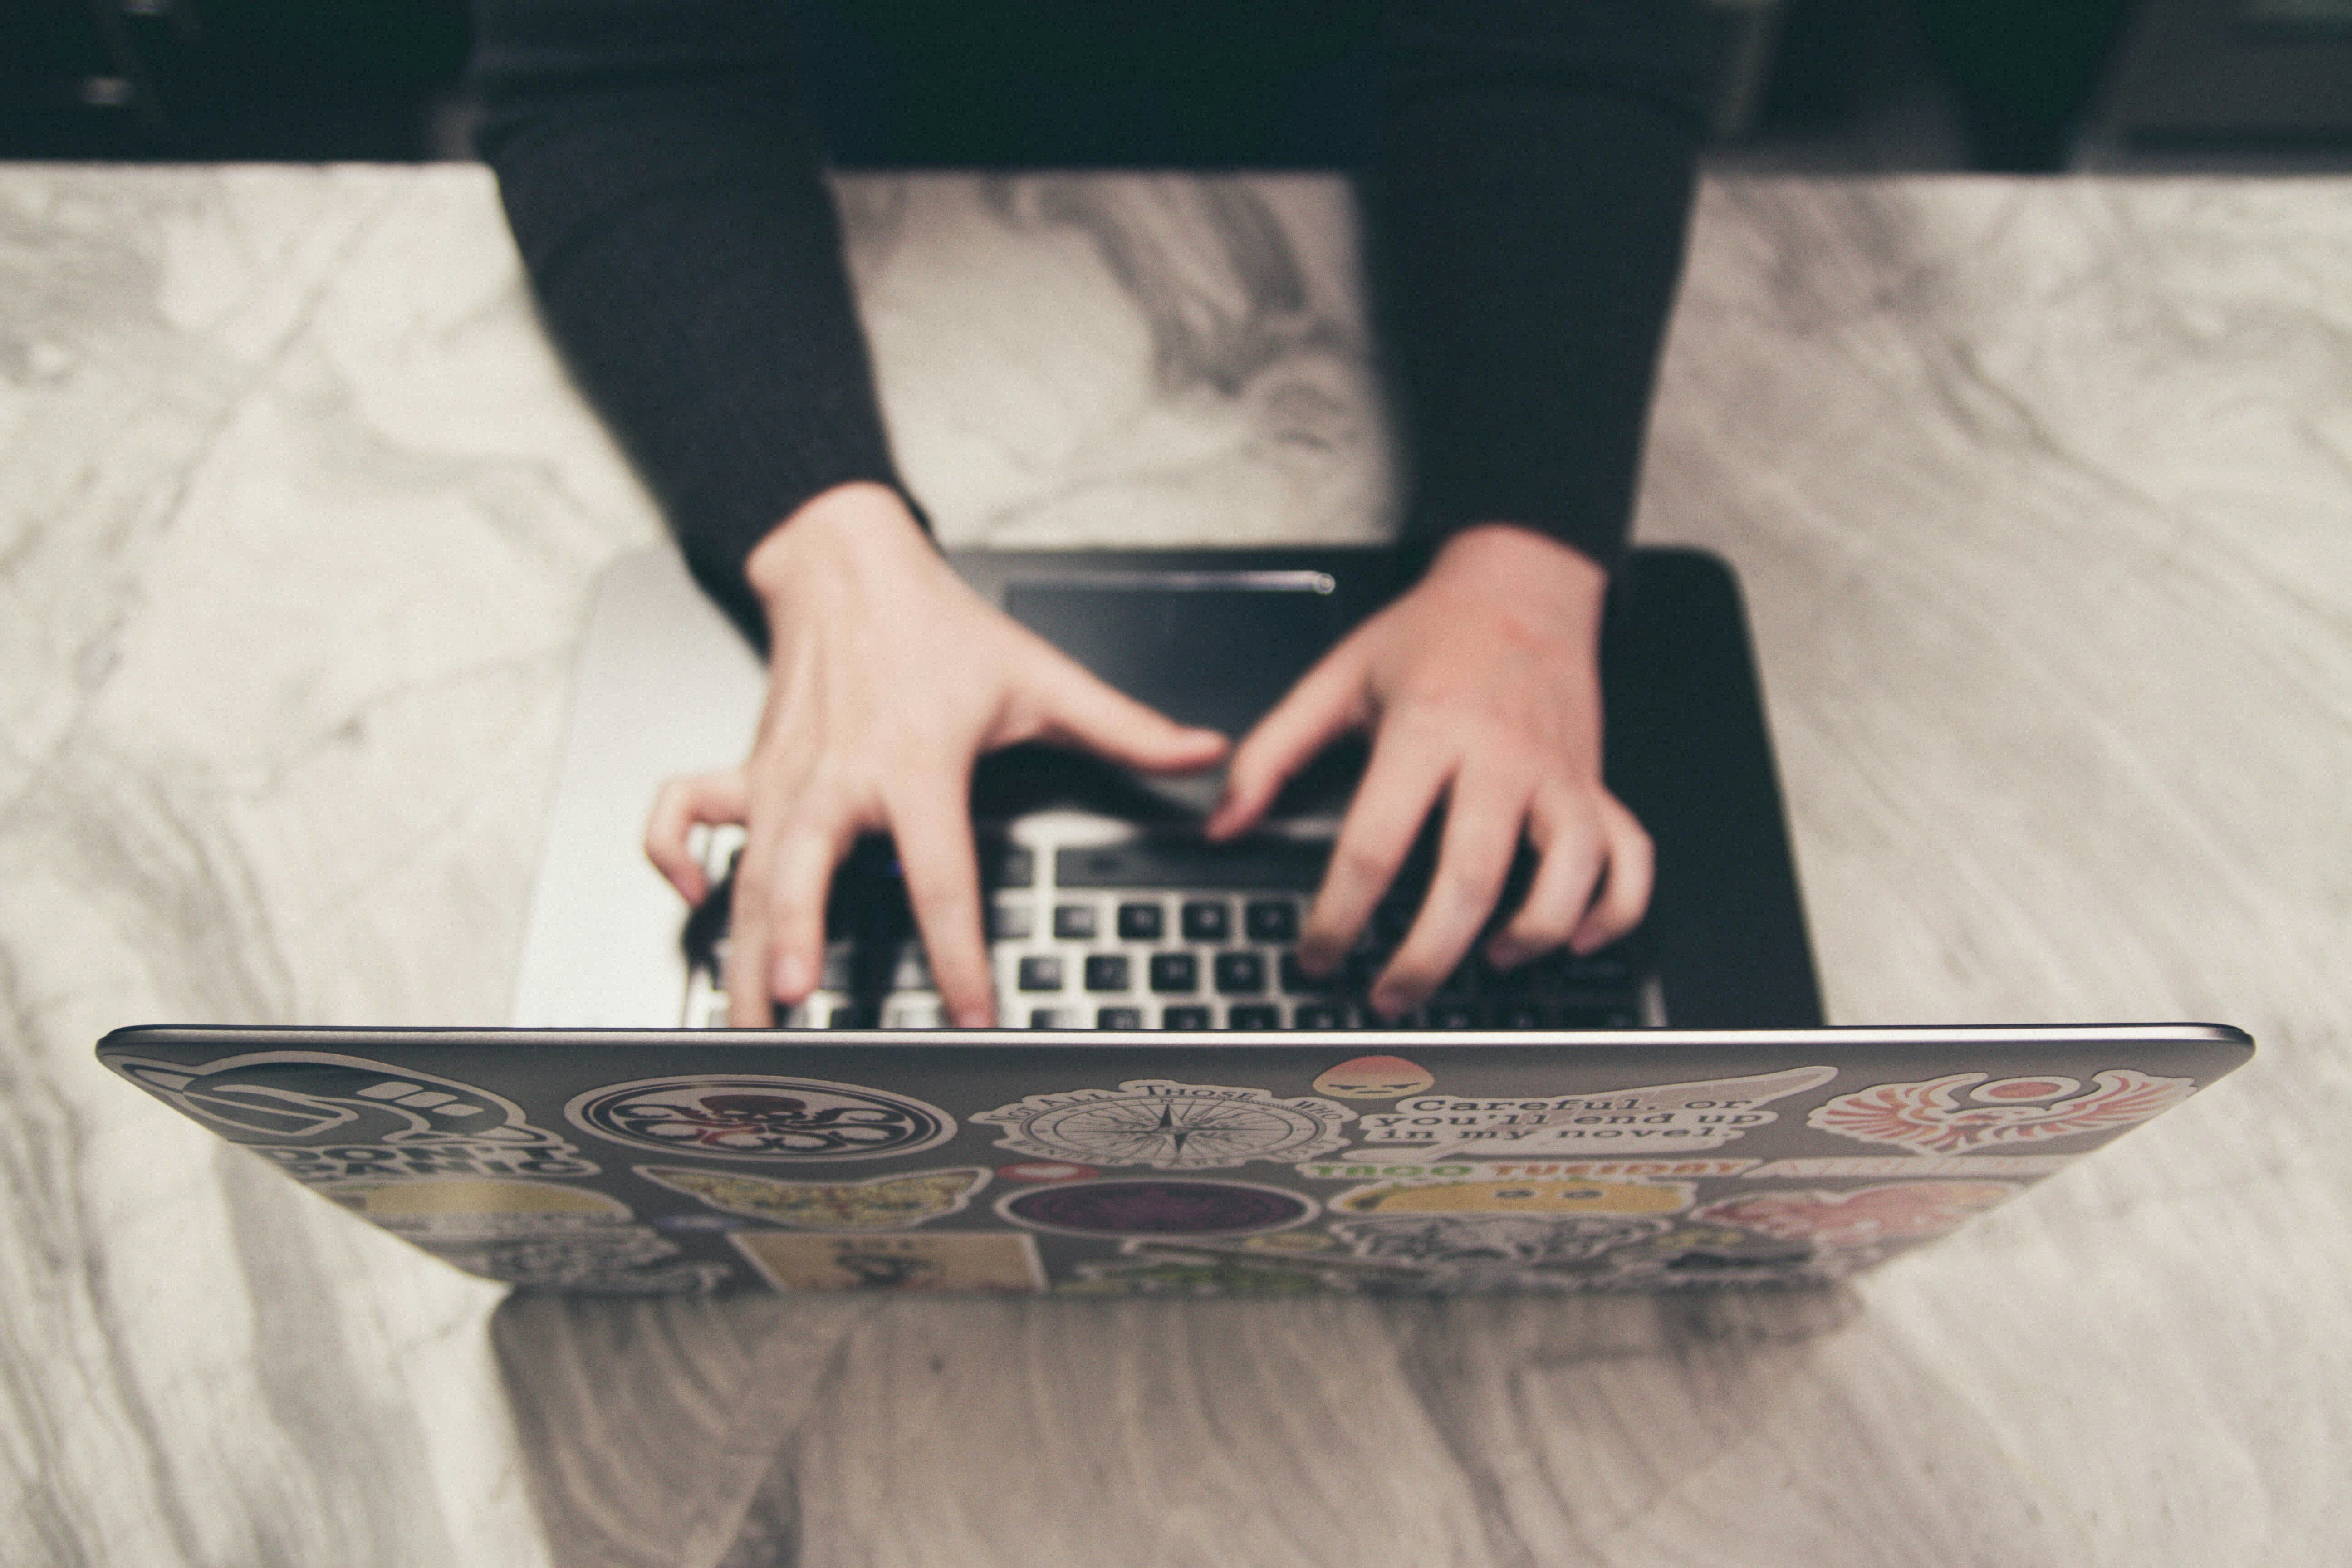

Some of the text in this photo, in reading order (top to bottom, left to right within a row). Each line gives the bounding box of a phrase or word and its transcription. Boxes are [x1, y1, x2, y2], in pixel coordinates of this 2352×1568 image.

[1040, 1093, 1112, 1107] ALL
[1136, 1085, 1257, 1099] THOSE
[1294, 1100, 1343, 1119] WHO
[1685, 1100, 1752, 1109] or
[1374, 1113, 1763, 1127] you'll end up
[1380, 1127, 1730, 1140] in my novel.
[254, 1146, 563, 1161] DON'T
[287, 1161, 589, 1175] PANIC
[1312, 1161, 1744, 1176] TACO TUESDAY
